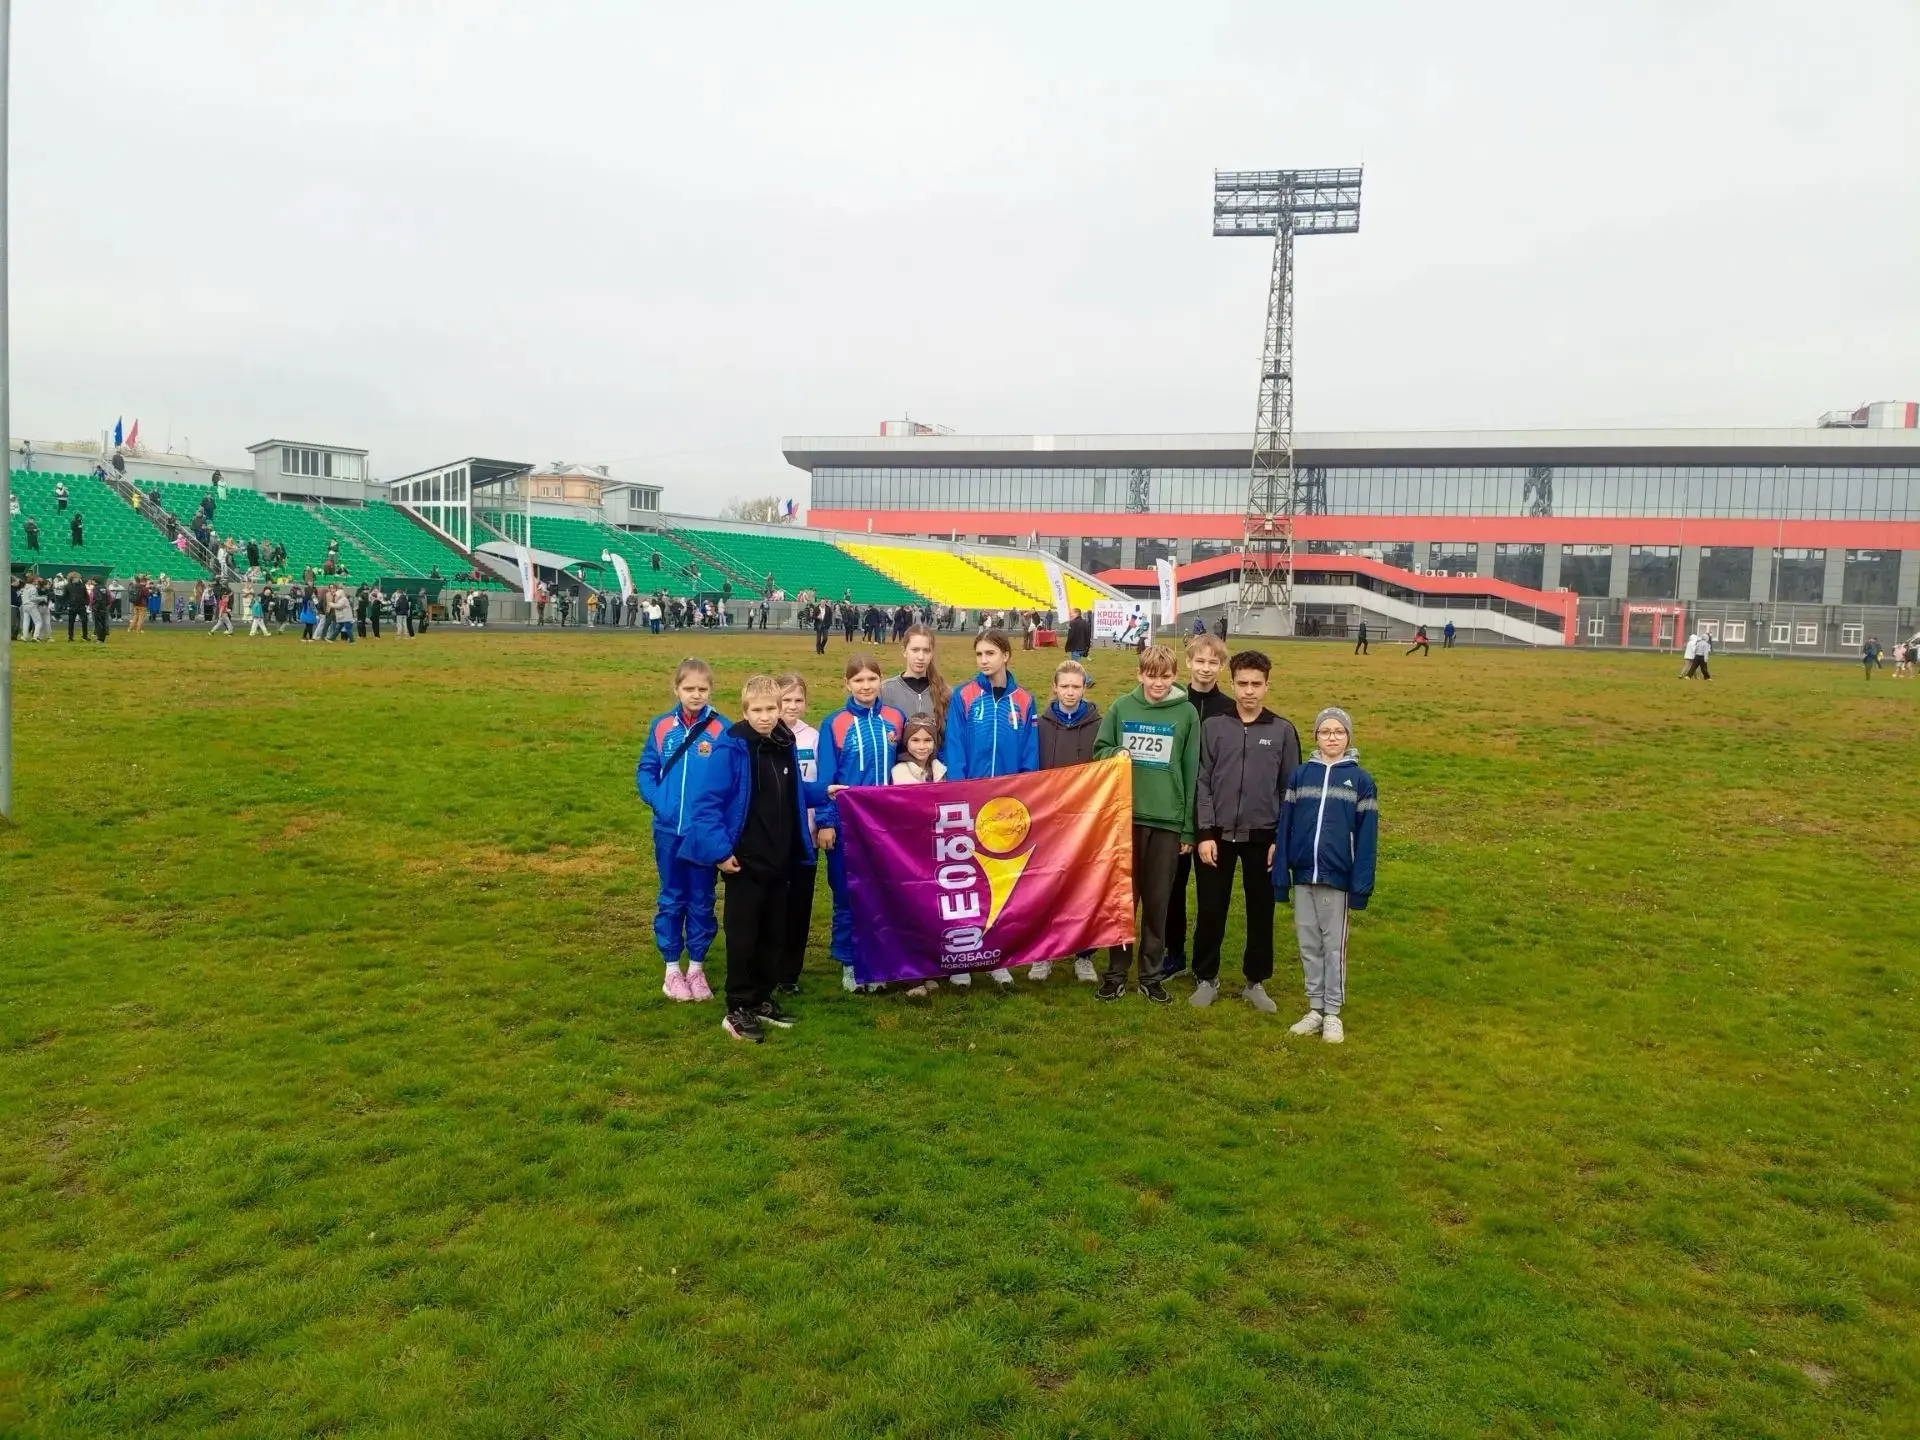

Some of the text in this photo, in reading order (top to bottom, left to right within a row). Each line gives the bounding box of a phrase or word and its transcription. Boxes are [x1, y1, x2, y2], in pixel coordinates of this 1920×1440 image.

[1097, 610, 1123, 619] КРОСС
[1097, 618, 1123, 627] НАЦИИ
[1129, 735, 1163, 753] 2725
[941, 948, 1002, 963] КУЗБАСС
